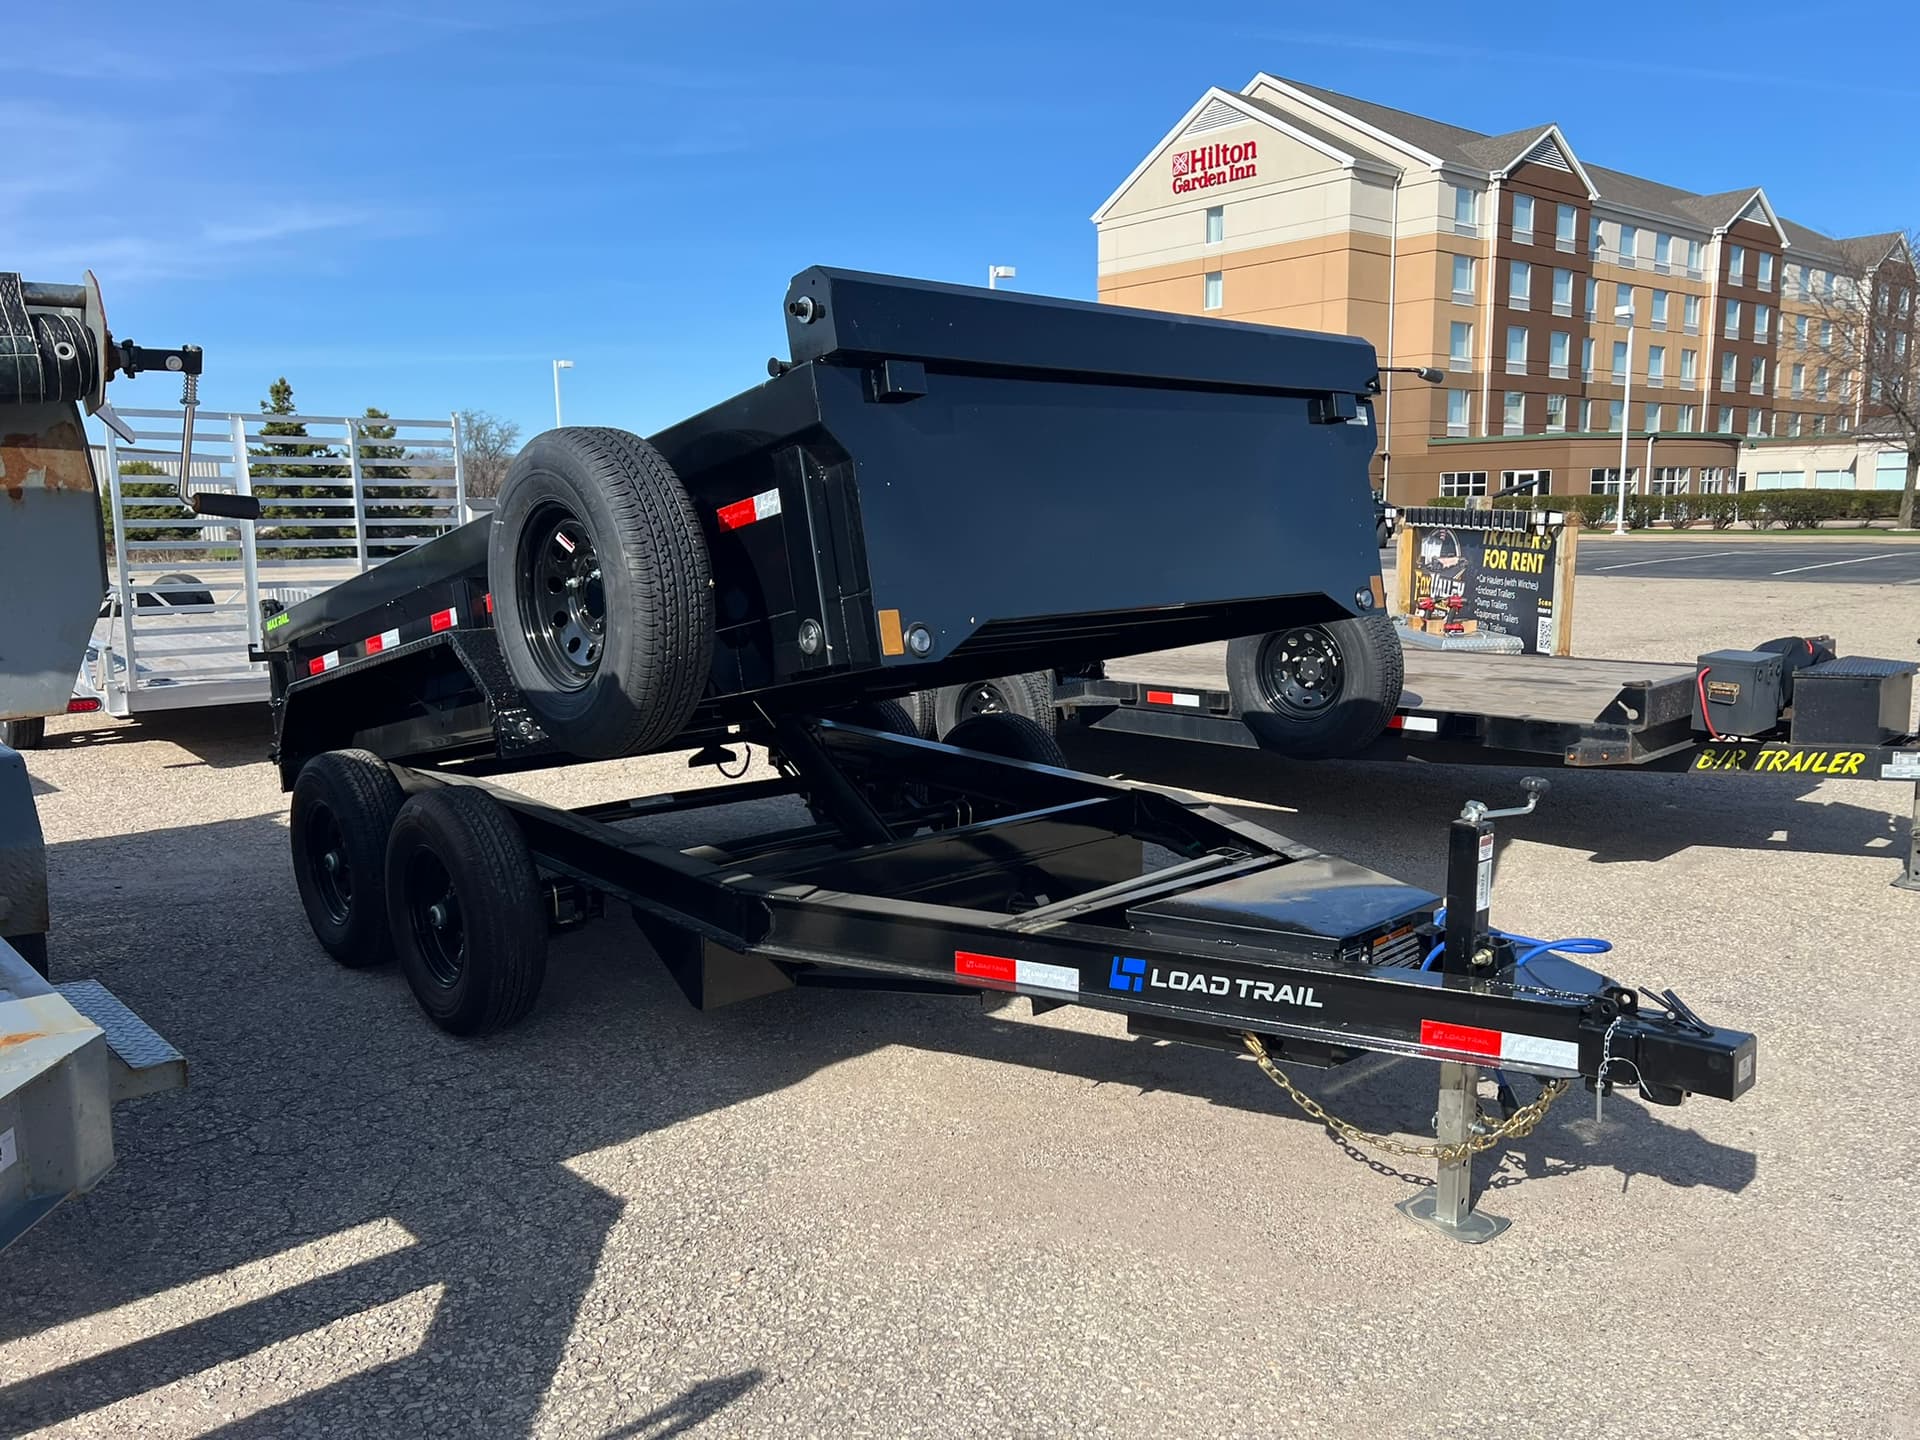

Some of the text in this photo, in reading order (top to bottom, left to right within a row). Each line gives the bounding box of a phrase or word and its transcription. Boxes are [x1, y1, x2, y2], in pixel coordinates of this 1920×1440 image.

[1190, 140, 1257, 173] Hilton
[1172, 163, 1257, 194] Garden Inn
[1483, 548, 1545, 574] FOR RENT
[1491, 599, 1508, 610] Trailers
[1498, 588, 1516, 599] Trailers
[1501, 613, 1519, 624] Trailers
[1696, 749, 1748, 770] B/R
[1754, 749, 1867, 775] TRAILER
[1150, 968, 1323, 1008] LOAD TRAIL
